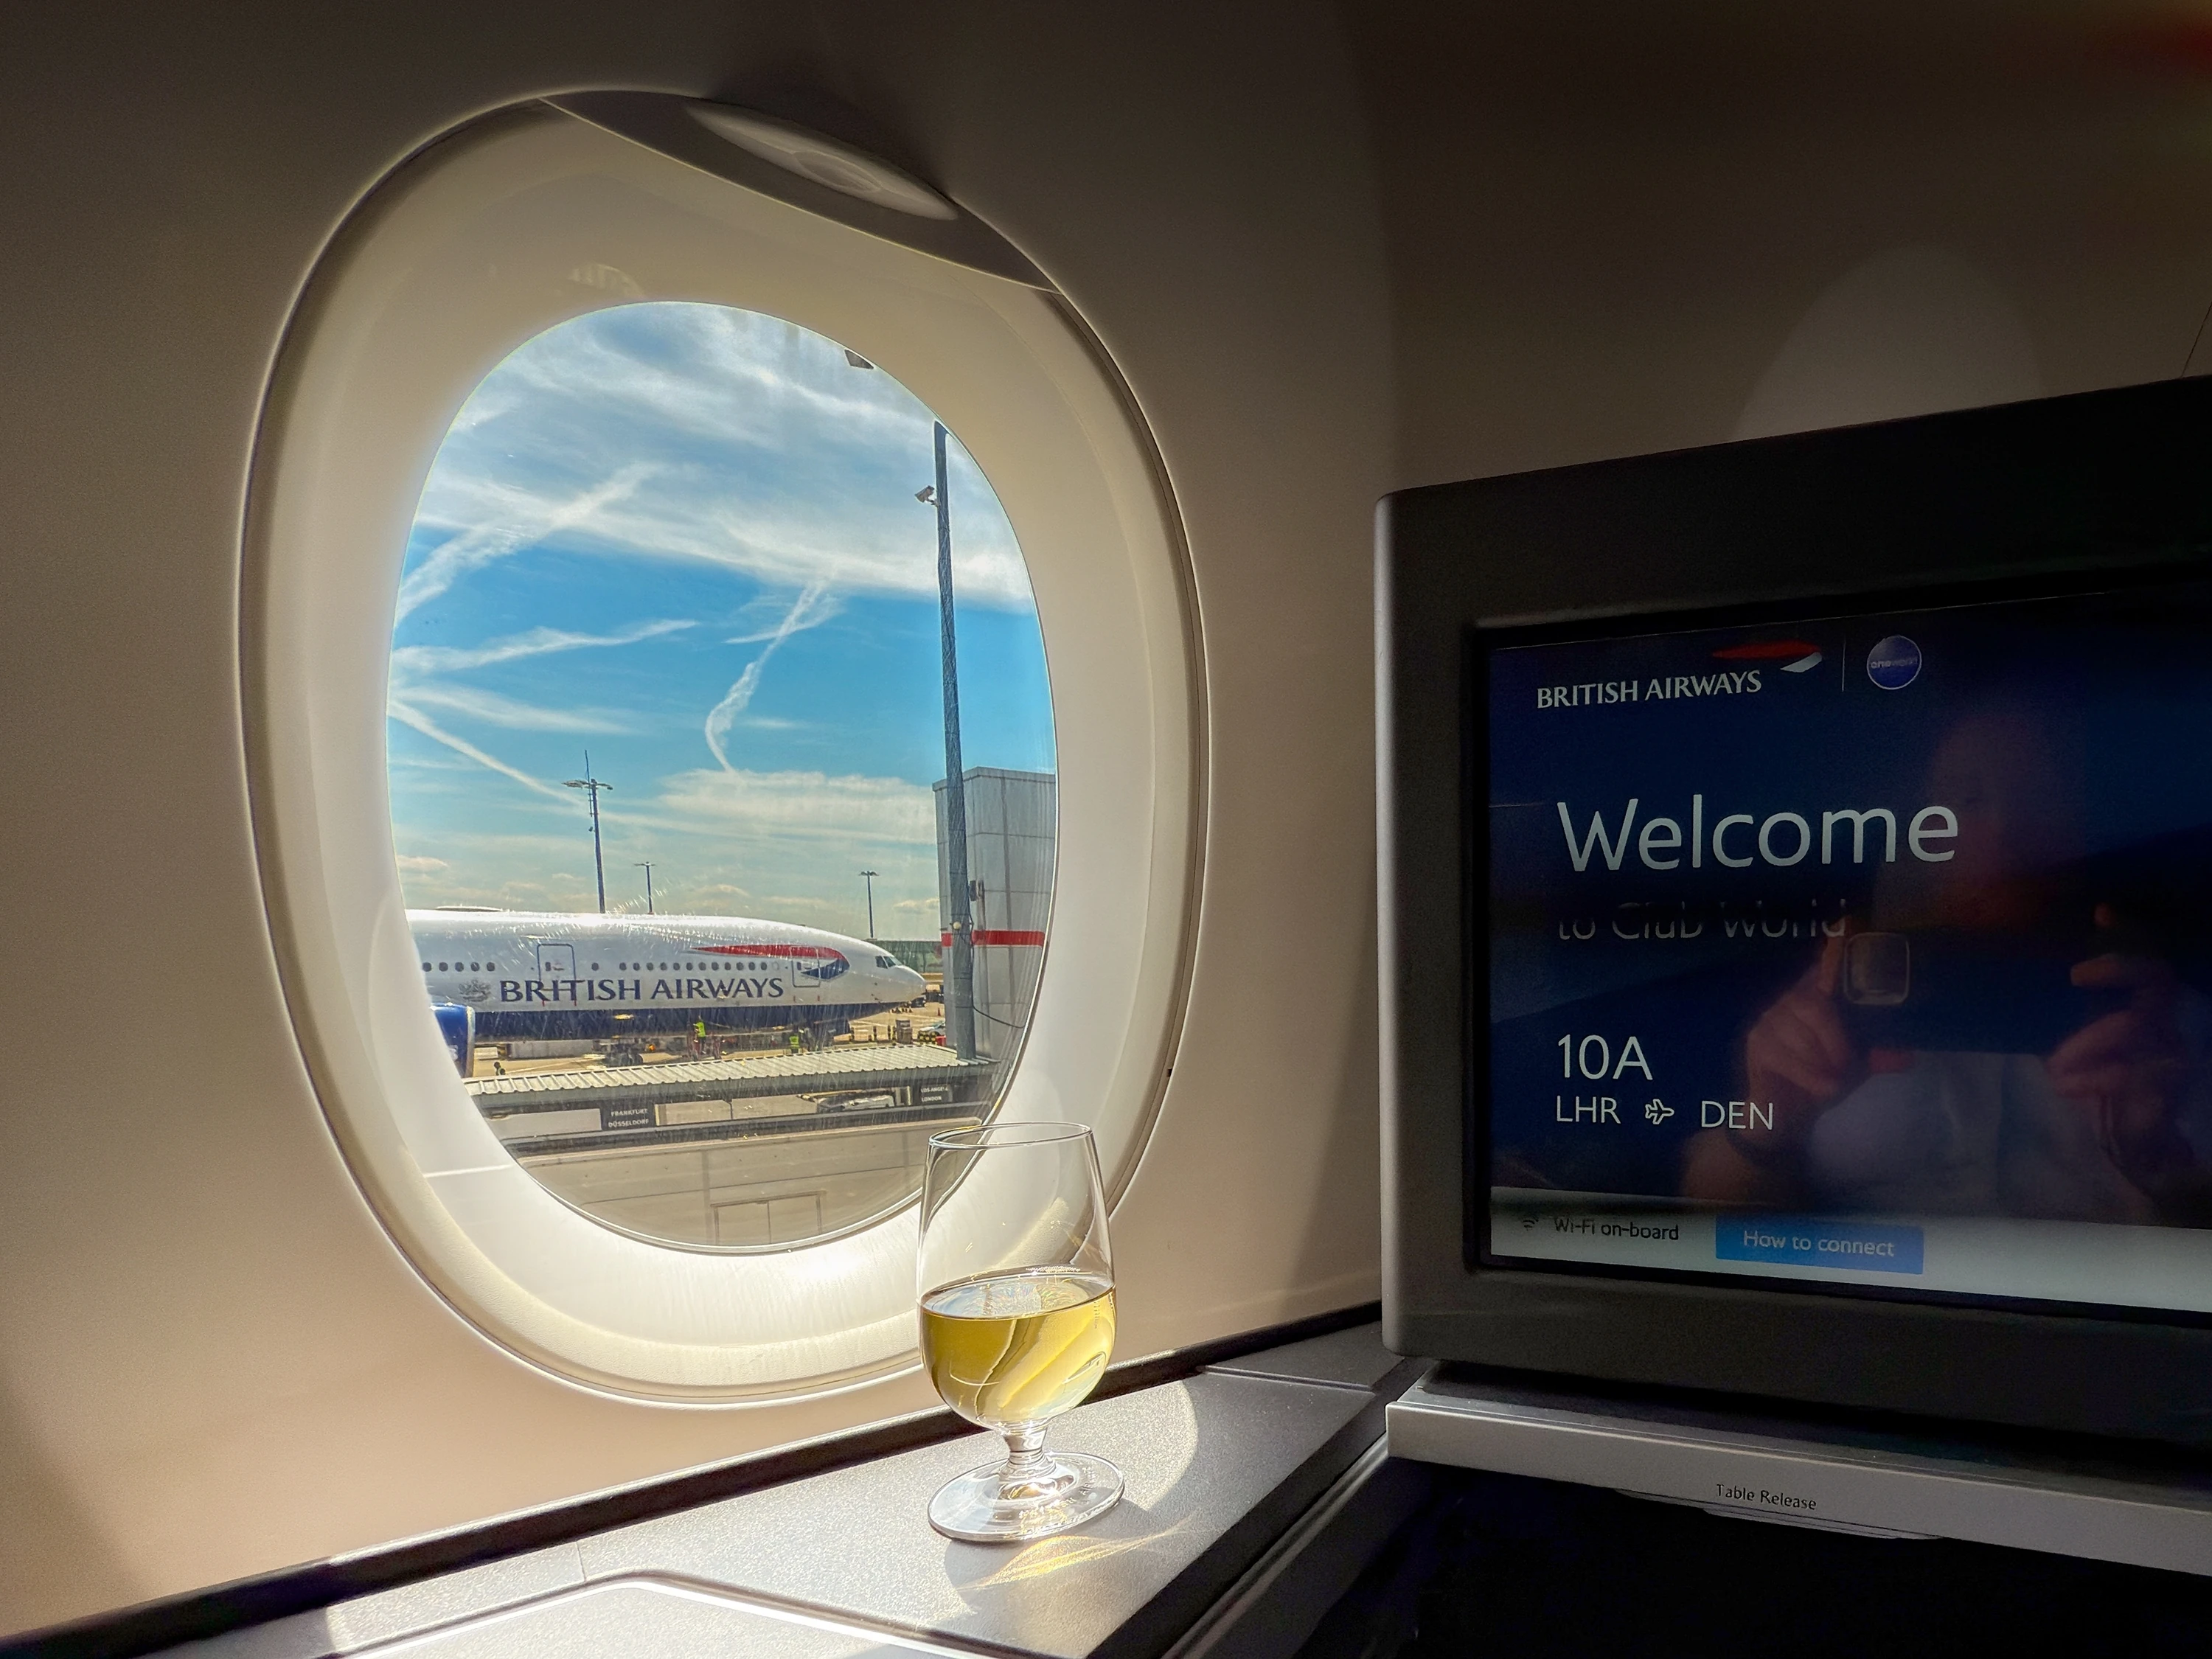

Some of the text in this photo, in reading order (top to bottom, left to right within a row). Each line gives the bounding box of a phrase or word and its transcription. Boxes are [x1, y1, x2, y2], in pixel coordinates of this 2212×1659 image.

[1537, 669, 1762, 709] BRITISH AIRWAYS
[1557, 793, 1958, 872] Welcome
[1612, 900, 1703, 939] Club
[1720, 898, 1846, 939] World
[499, 977, 785, 1003] BRITISH AIRWAYS
[1557, 1033, 1654, 1081] 10A
[611, 1108, 648, 1117] FRANKFURT
[1556, 1094, 1774, 1131] LHR DEN
[1554, 1217, 1679, 1240] Wi-Fi on-board
[1743, 1230, 1895, 1256] How to connect
[1717, 1484, 1817, 1510] Table Release
